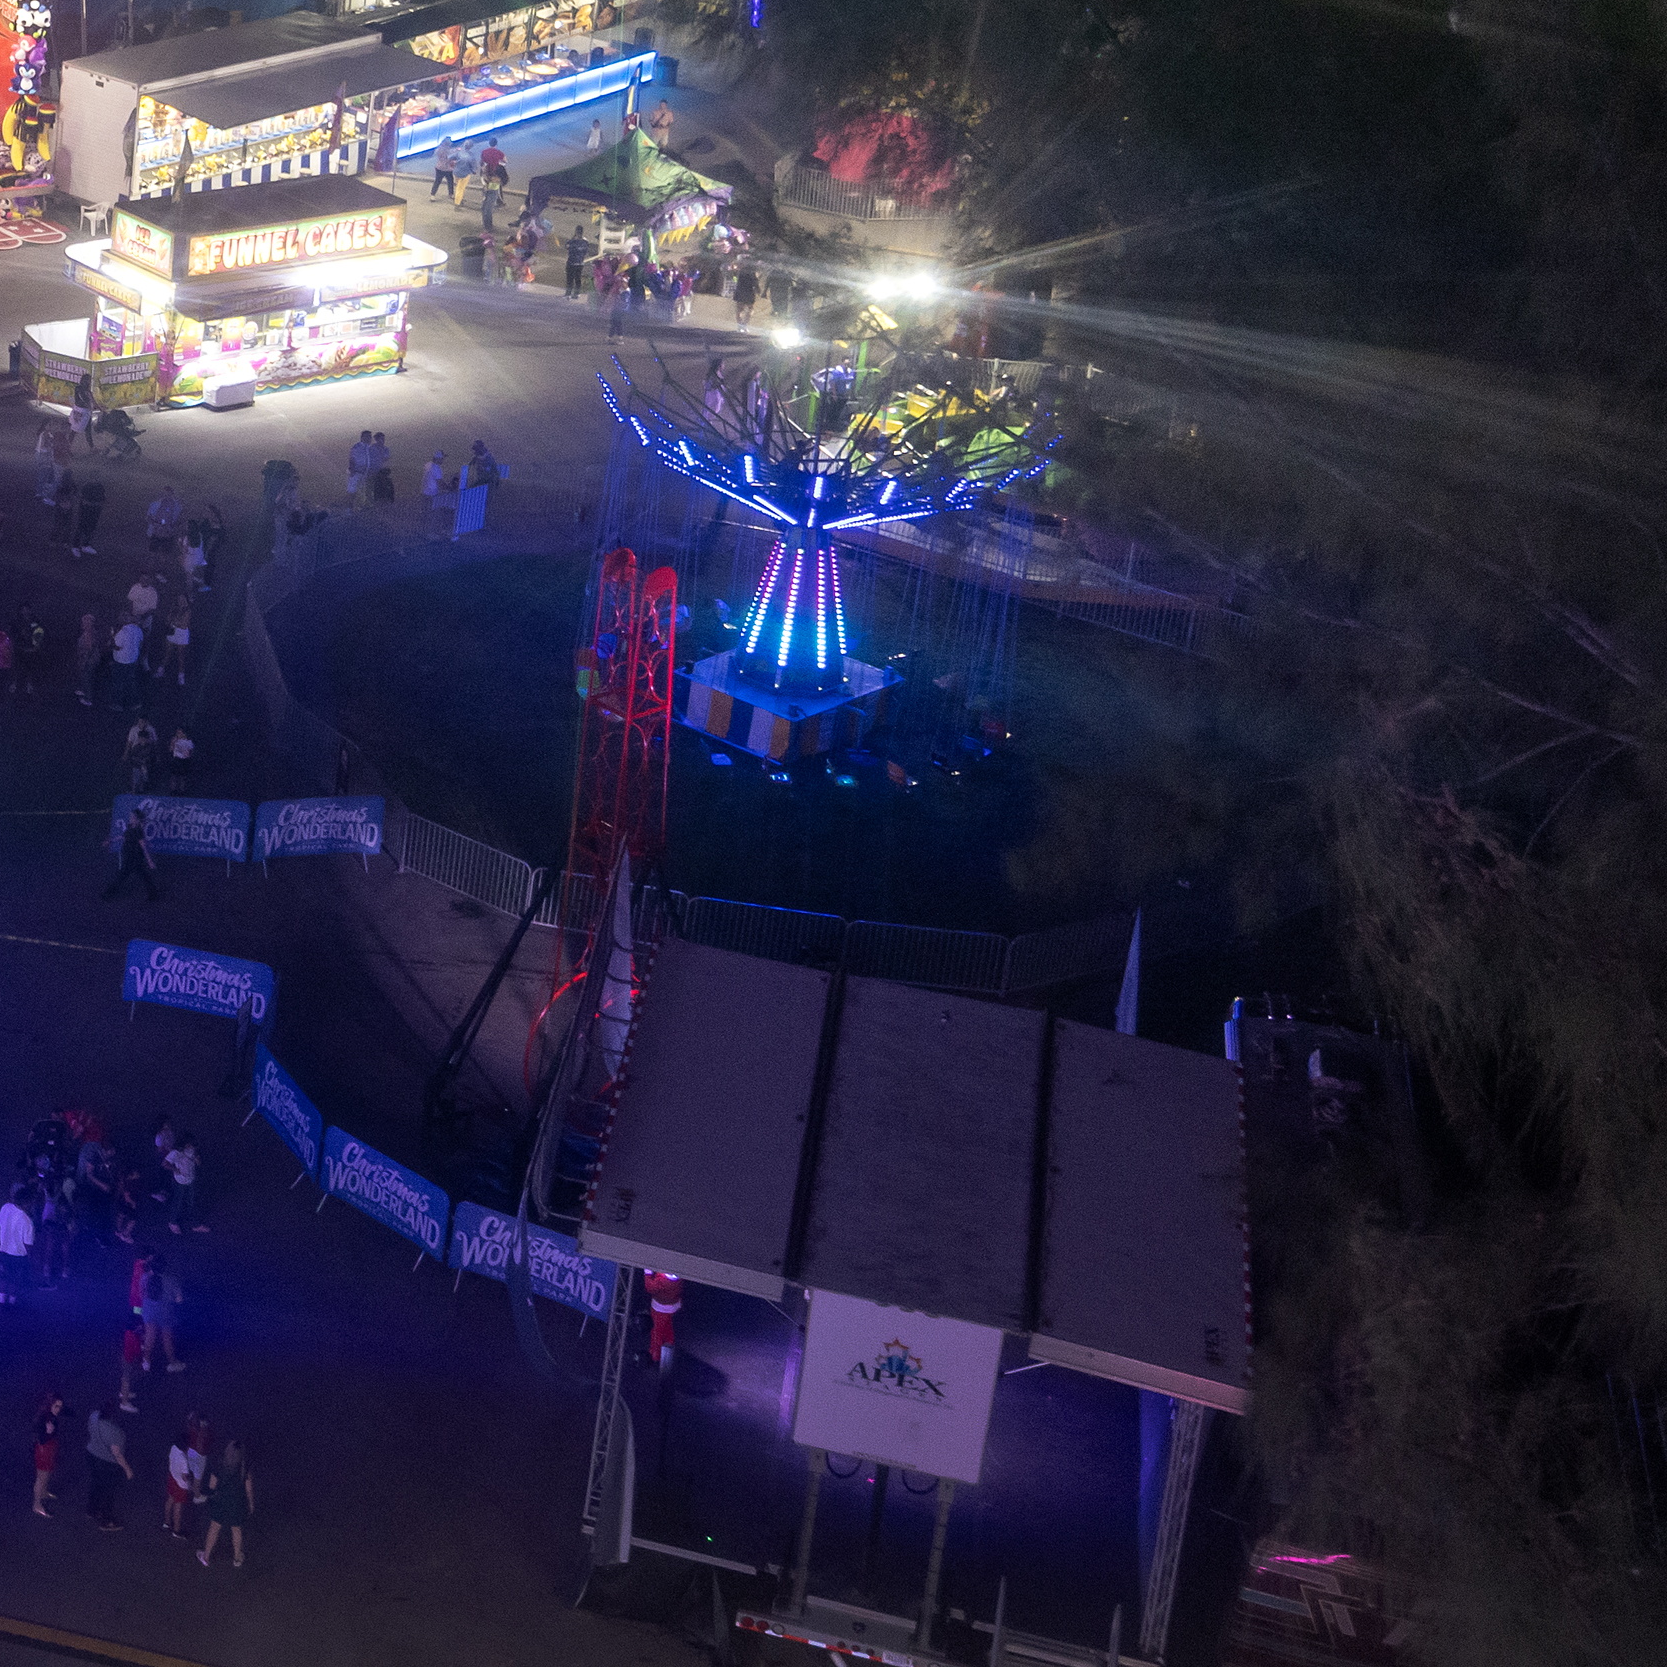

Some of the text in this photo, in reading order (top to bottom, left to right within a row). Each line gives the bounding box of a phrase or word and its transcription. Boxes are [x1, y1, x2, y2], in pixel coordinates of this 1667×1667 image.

[134, 224, 152, 245] ICE
[208, 216, 385, 273] FUNNEL CAKES
[356, 274, 416, 293] LEMONADE
[104, 361, 150, 376] STRAWBERRY
[138, 798, 232, 828] Christmas
[278, 803, 369, 828] Christmas
[116, 818, 245, 855] ONDERLAND
[258, 822, 380, 857] WONDERLAND
[150, 946, 254, 991] Christmas
[130, 965, 267, 1020] WONDERLAND
[158, 993, 208, 1010] TROPICAL
[266, 1060, 312, 1134] Christmas
[255, 1073, 316, 1170] WONDERLAND
[341, 1140, 431, 1214] Christmas
[325, 1154, 441, 1250] WONDERLAND
[845, 1360, 948, 1402] APEX
